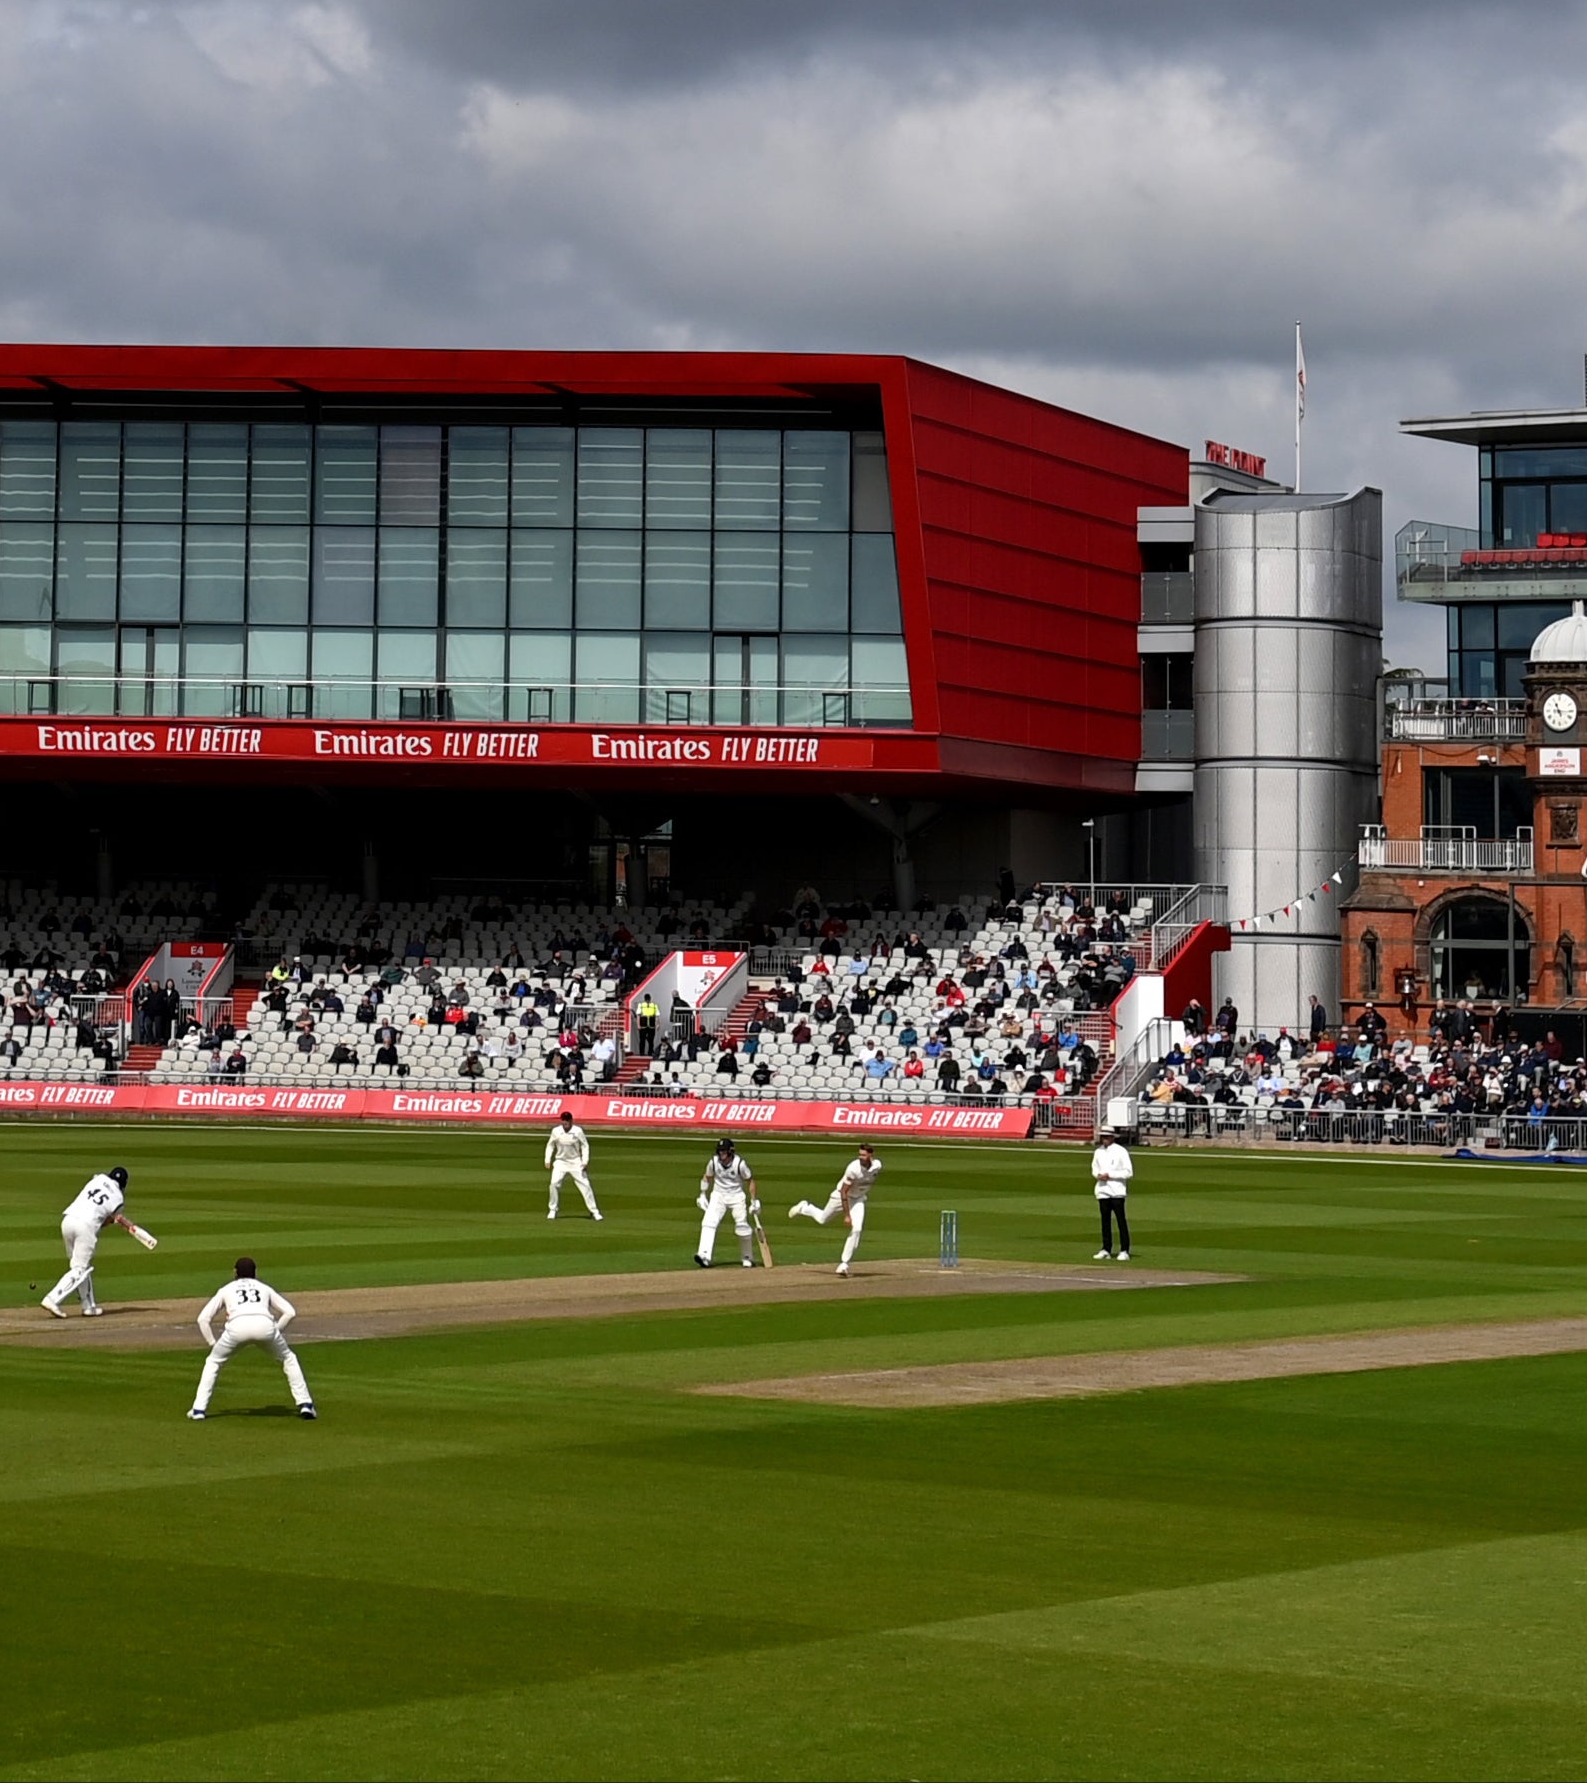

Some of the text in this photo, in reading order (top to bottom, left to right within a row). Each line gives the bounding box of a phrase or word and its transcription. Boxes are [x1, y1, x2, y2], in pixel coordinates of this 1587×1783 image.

[1205, 440, 1229, 466] THE
[38, 726, 261, 752] Emirates FLY BETTER
[314, 730, 539, 757] Emirates FLY BETTER
[592, 734, 818, 762] Emirates FLY BETTER
[190, 945, 204, 955] E4
[702, 955, 717, 964] E5
[40, 1086, 65, 1104] FLY
[68, 1087, 114, 1105] BETTER
[177, 1089, 346, 1110] Emirates FLY BETTER
[392, 1095, 562, 1115] Emirates FLY BETTER
[607, 1101, 776, 1122] Emirates FLY BETTER
[833, 1107, 1004, 1129] Emirates FLY BETTER
[87, 1188, 110, 1206] 45
[235, 1288, 262, 1305] 33
